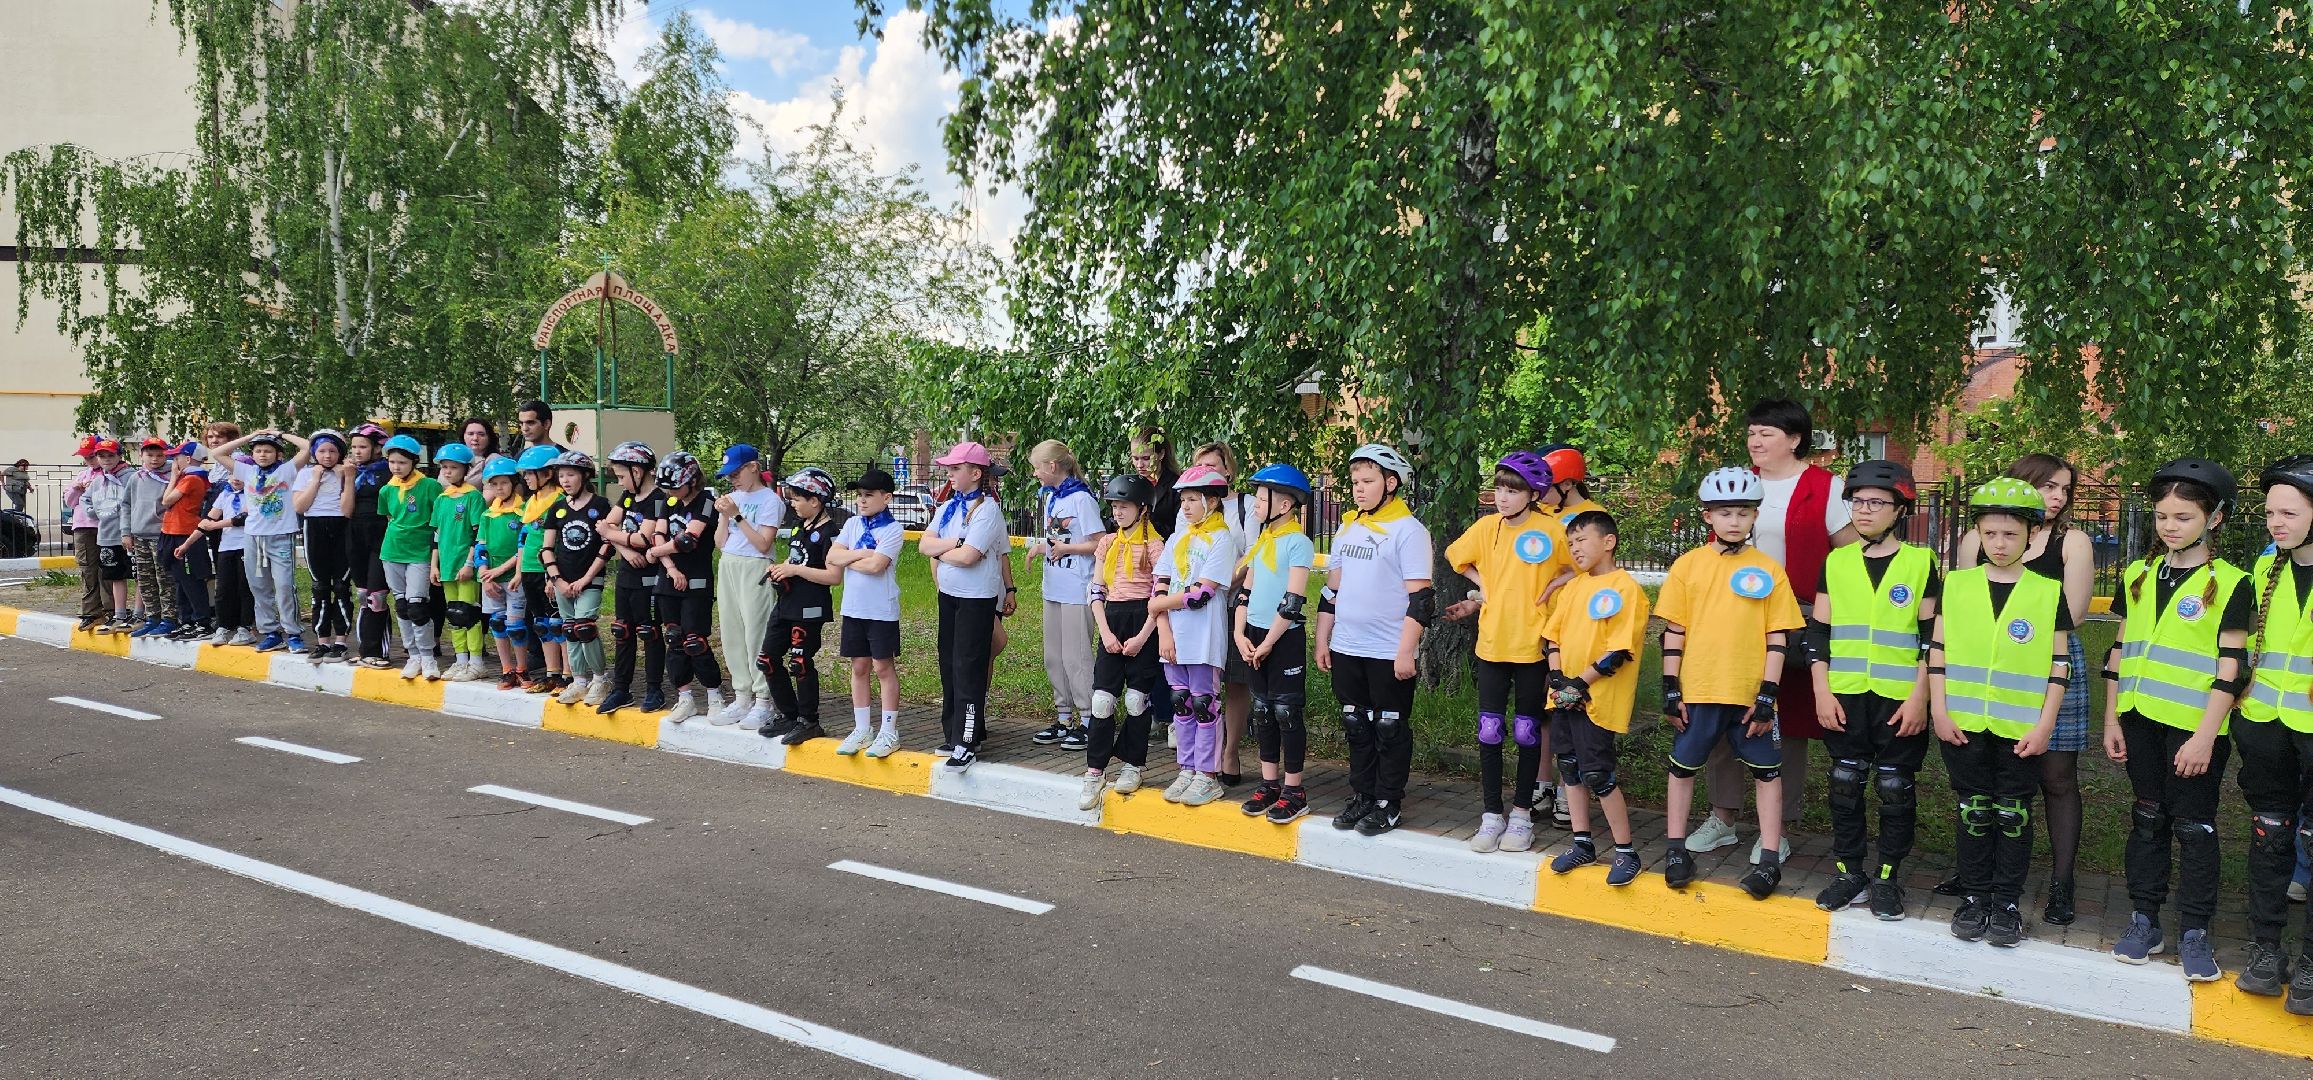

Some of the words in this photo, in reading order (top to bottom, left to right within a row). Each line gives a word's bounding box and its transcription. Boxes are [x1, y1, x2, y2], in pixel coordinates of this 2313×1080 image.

[536, 286, 602, 350] ТРАНСПОРТНАЯ
[613, 285, 675, 352] ПЛОЩАДКА
[1340, 544, 1373, 561] PUMA
